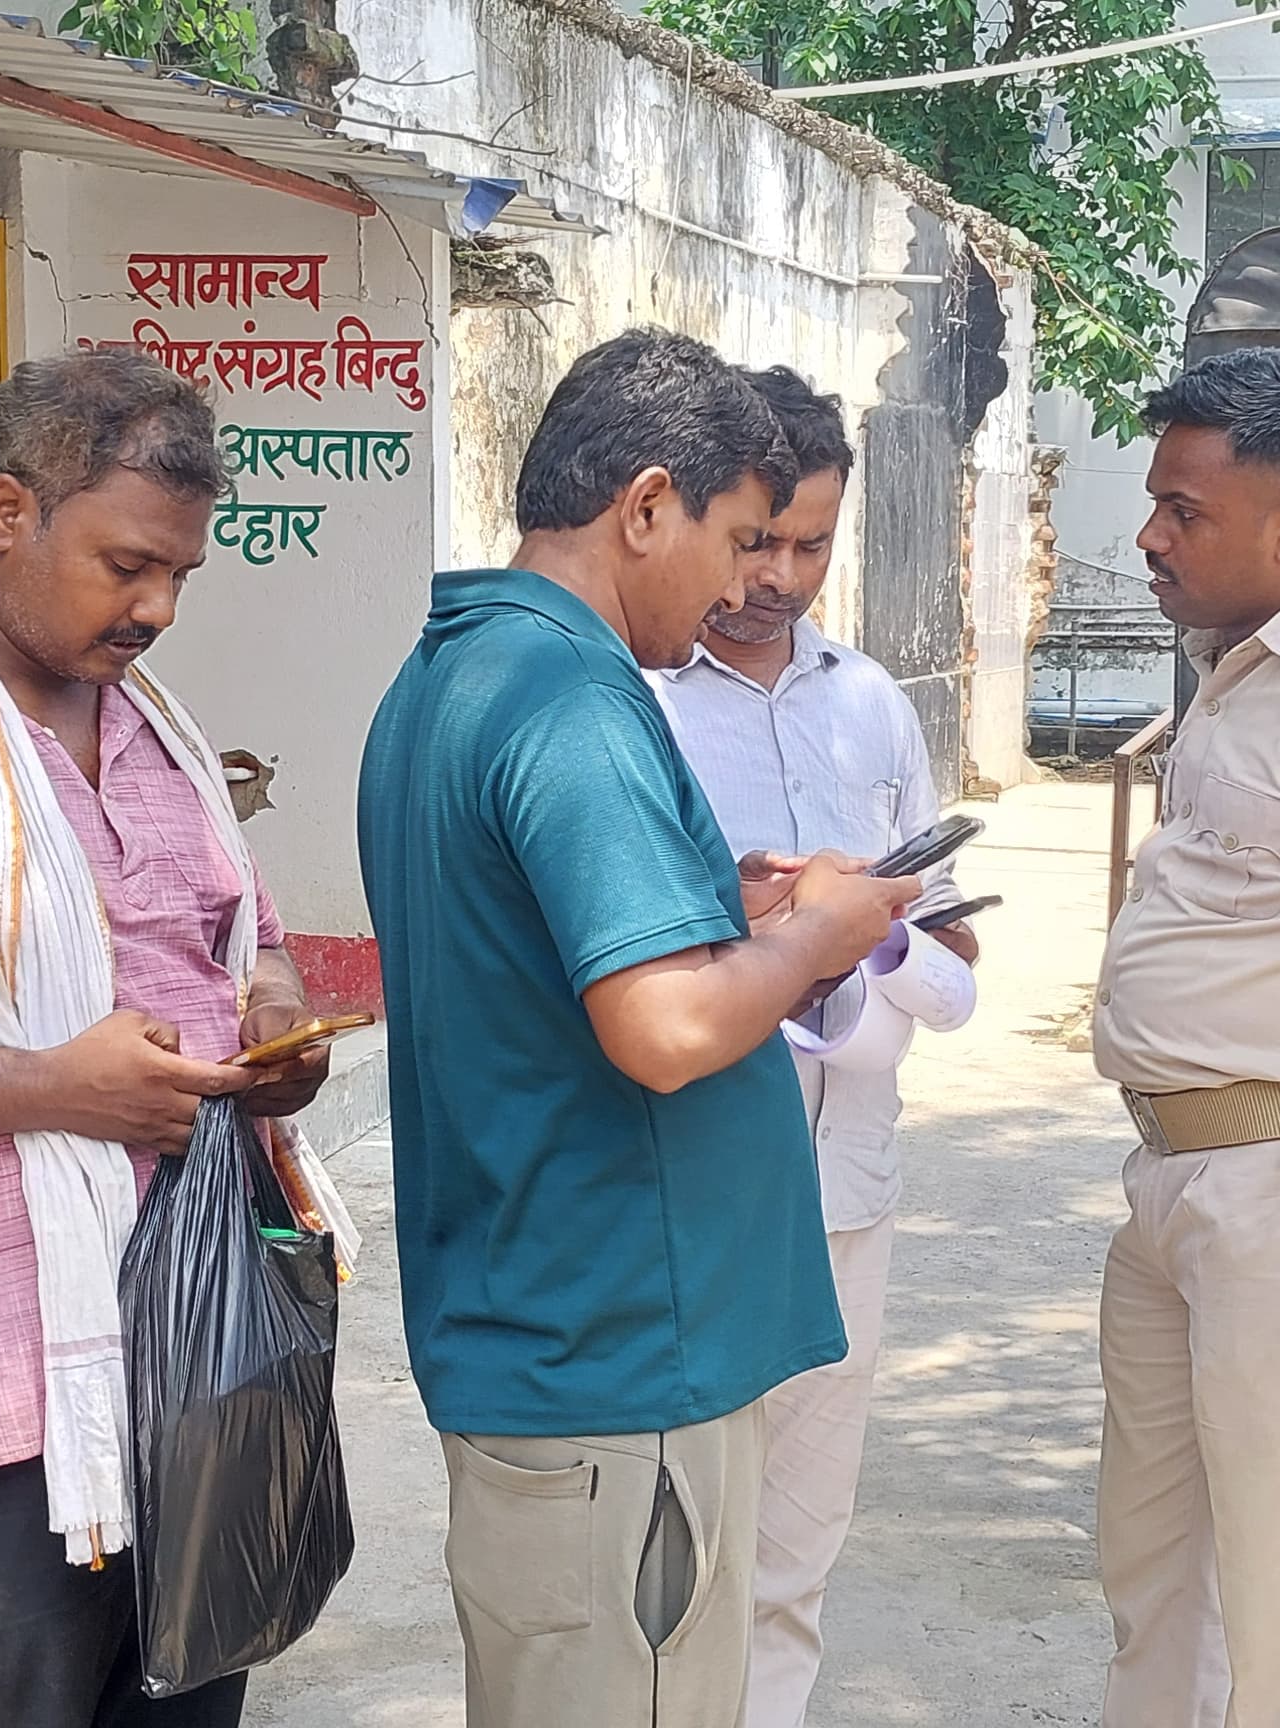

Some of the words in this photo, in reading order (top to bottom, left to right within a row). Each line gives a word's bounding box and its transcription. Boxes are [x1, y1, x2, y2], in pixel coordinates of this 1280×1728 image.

[127, 253, 328, 311] सामान्य
[214, 320, 327, 400] संग्रह
[331, 316, 427, 411] बिन्दु
[220, 424, 414, 482] अस्पताल
